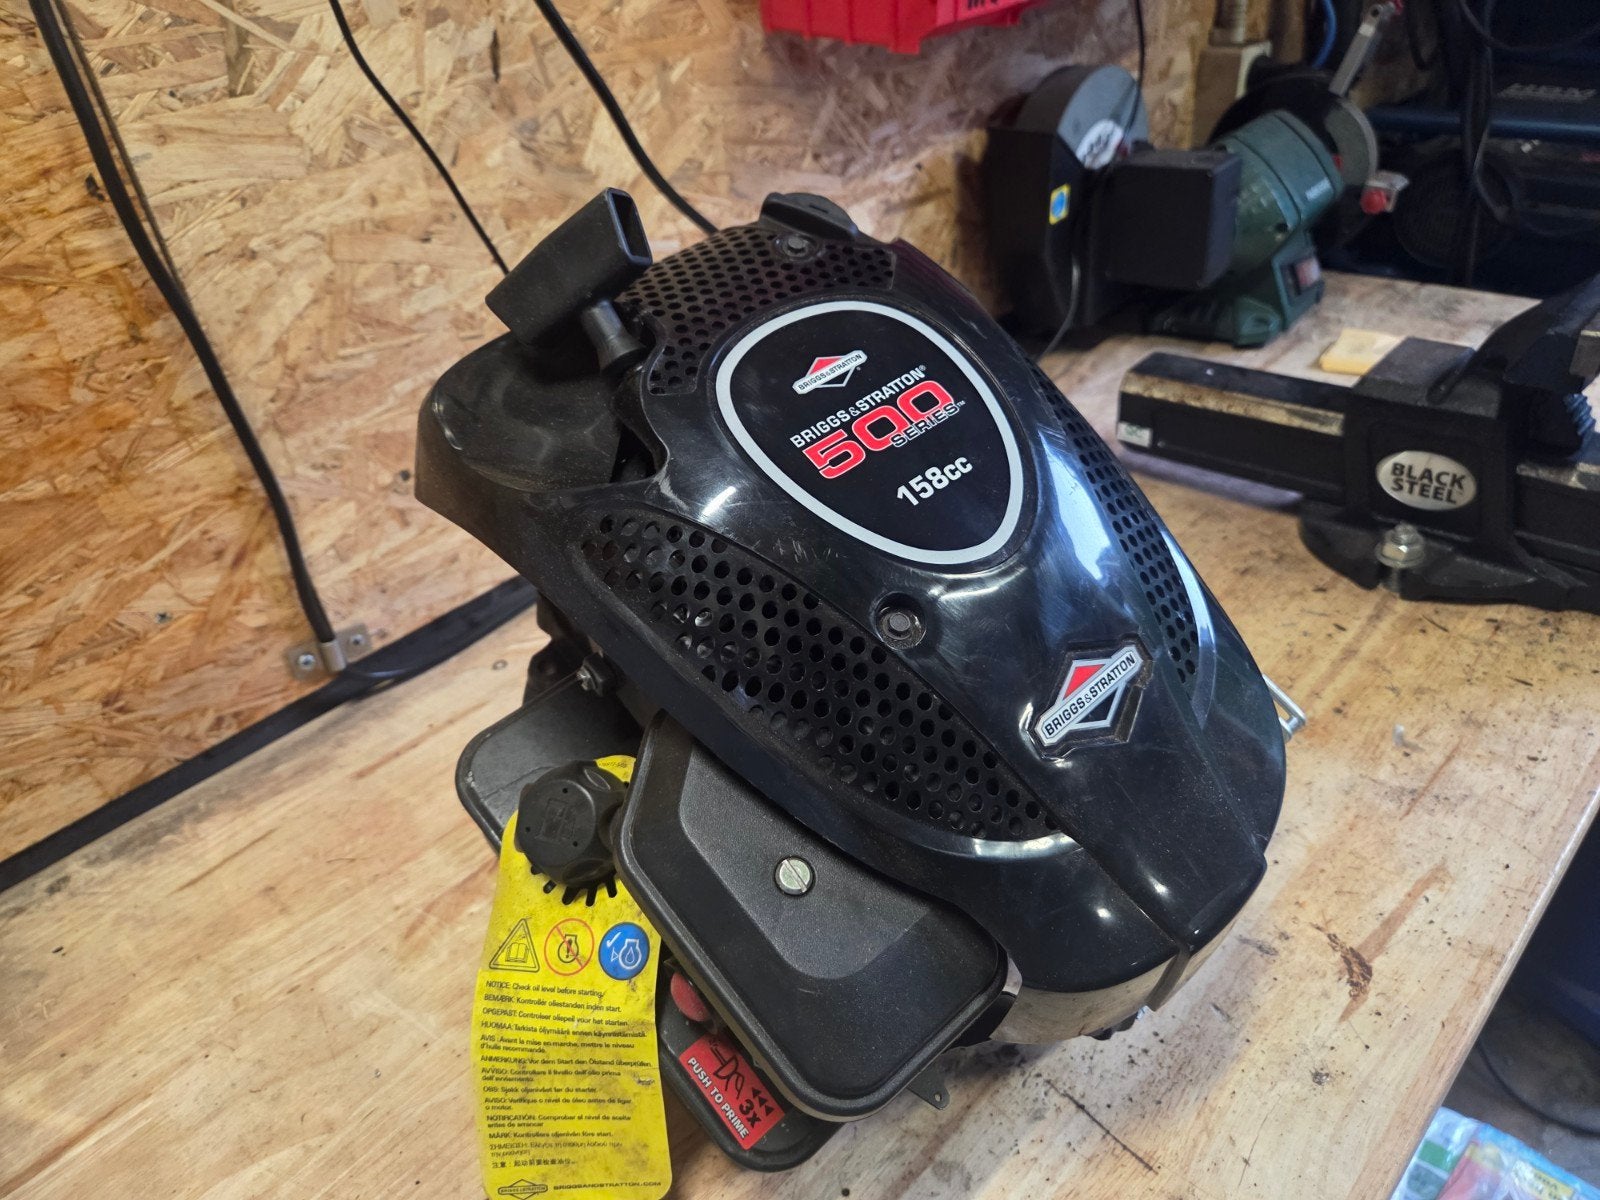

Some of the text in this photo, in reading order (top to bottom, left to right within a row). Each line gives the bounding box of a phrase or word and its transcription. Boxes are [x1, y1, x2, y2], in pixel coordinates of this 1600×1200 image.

[802, 380, 954, 479] 500
[896, 456, 973, 506] 158cc
[1391, 462, 1466, 490] BLACK
[1391, 478, 1457, 505] STEEL
[1045, 653, 1136, 736] BRIGGS&STRATTON
[486, 980, 511, 989] NOTICE:
[688, 1057, 750, 1139] PUSH TO PRIME
